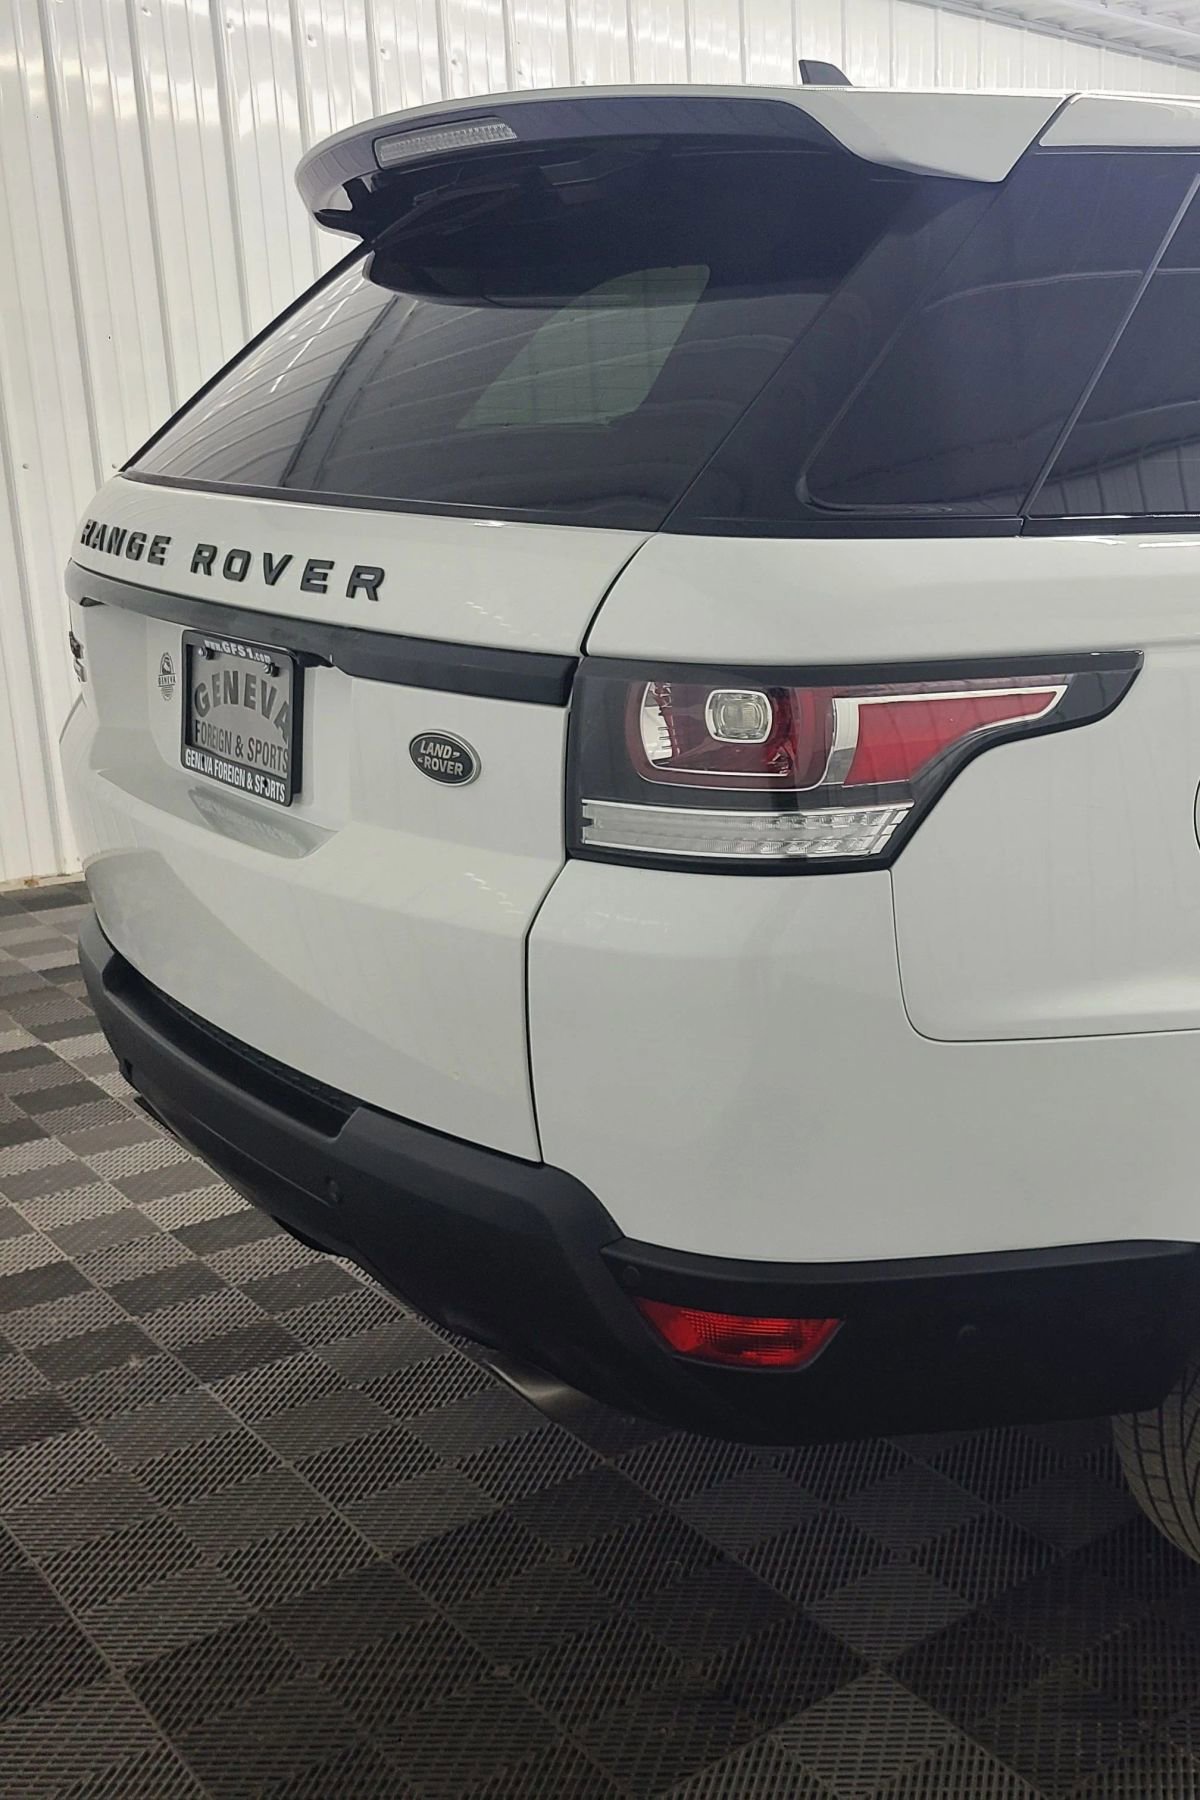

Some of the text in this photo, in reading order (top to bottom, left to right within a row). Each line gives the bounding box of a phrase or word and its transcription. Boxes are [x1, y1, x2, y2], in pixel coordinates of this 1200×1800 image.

[80, 518, 386, 602] RANGE ROVER
[204, 640, 271, 664] www.GFS1.com
[194, 670, 290, 745] GENEVA
[194, 719, 289, 774] FOREIGN & SPORTS
[420, 740, 453, 759] LAND
[214, 758, 246, 788] FOREIGN
[246, 771, 254, 790] &
[423, 755, 464, 777] ROVER
